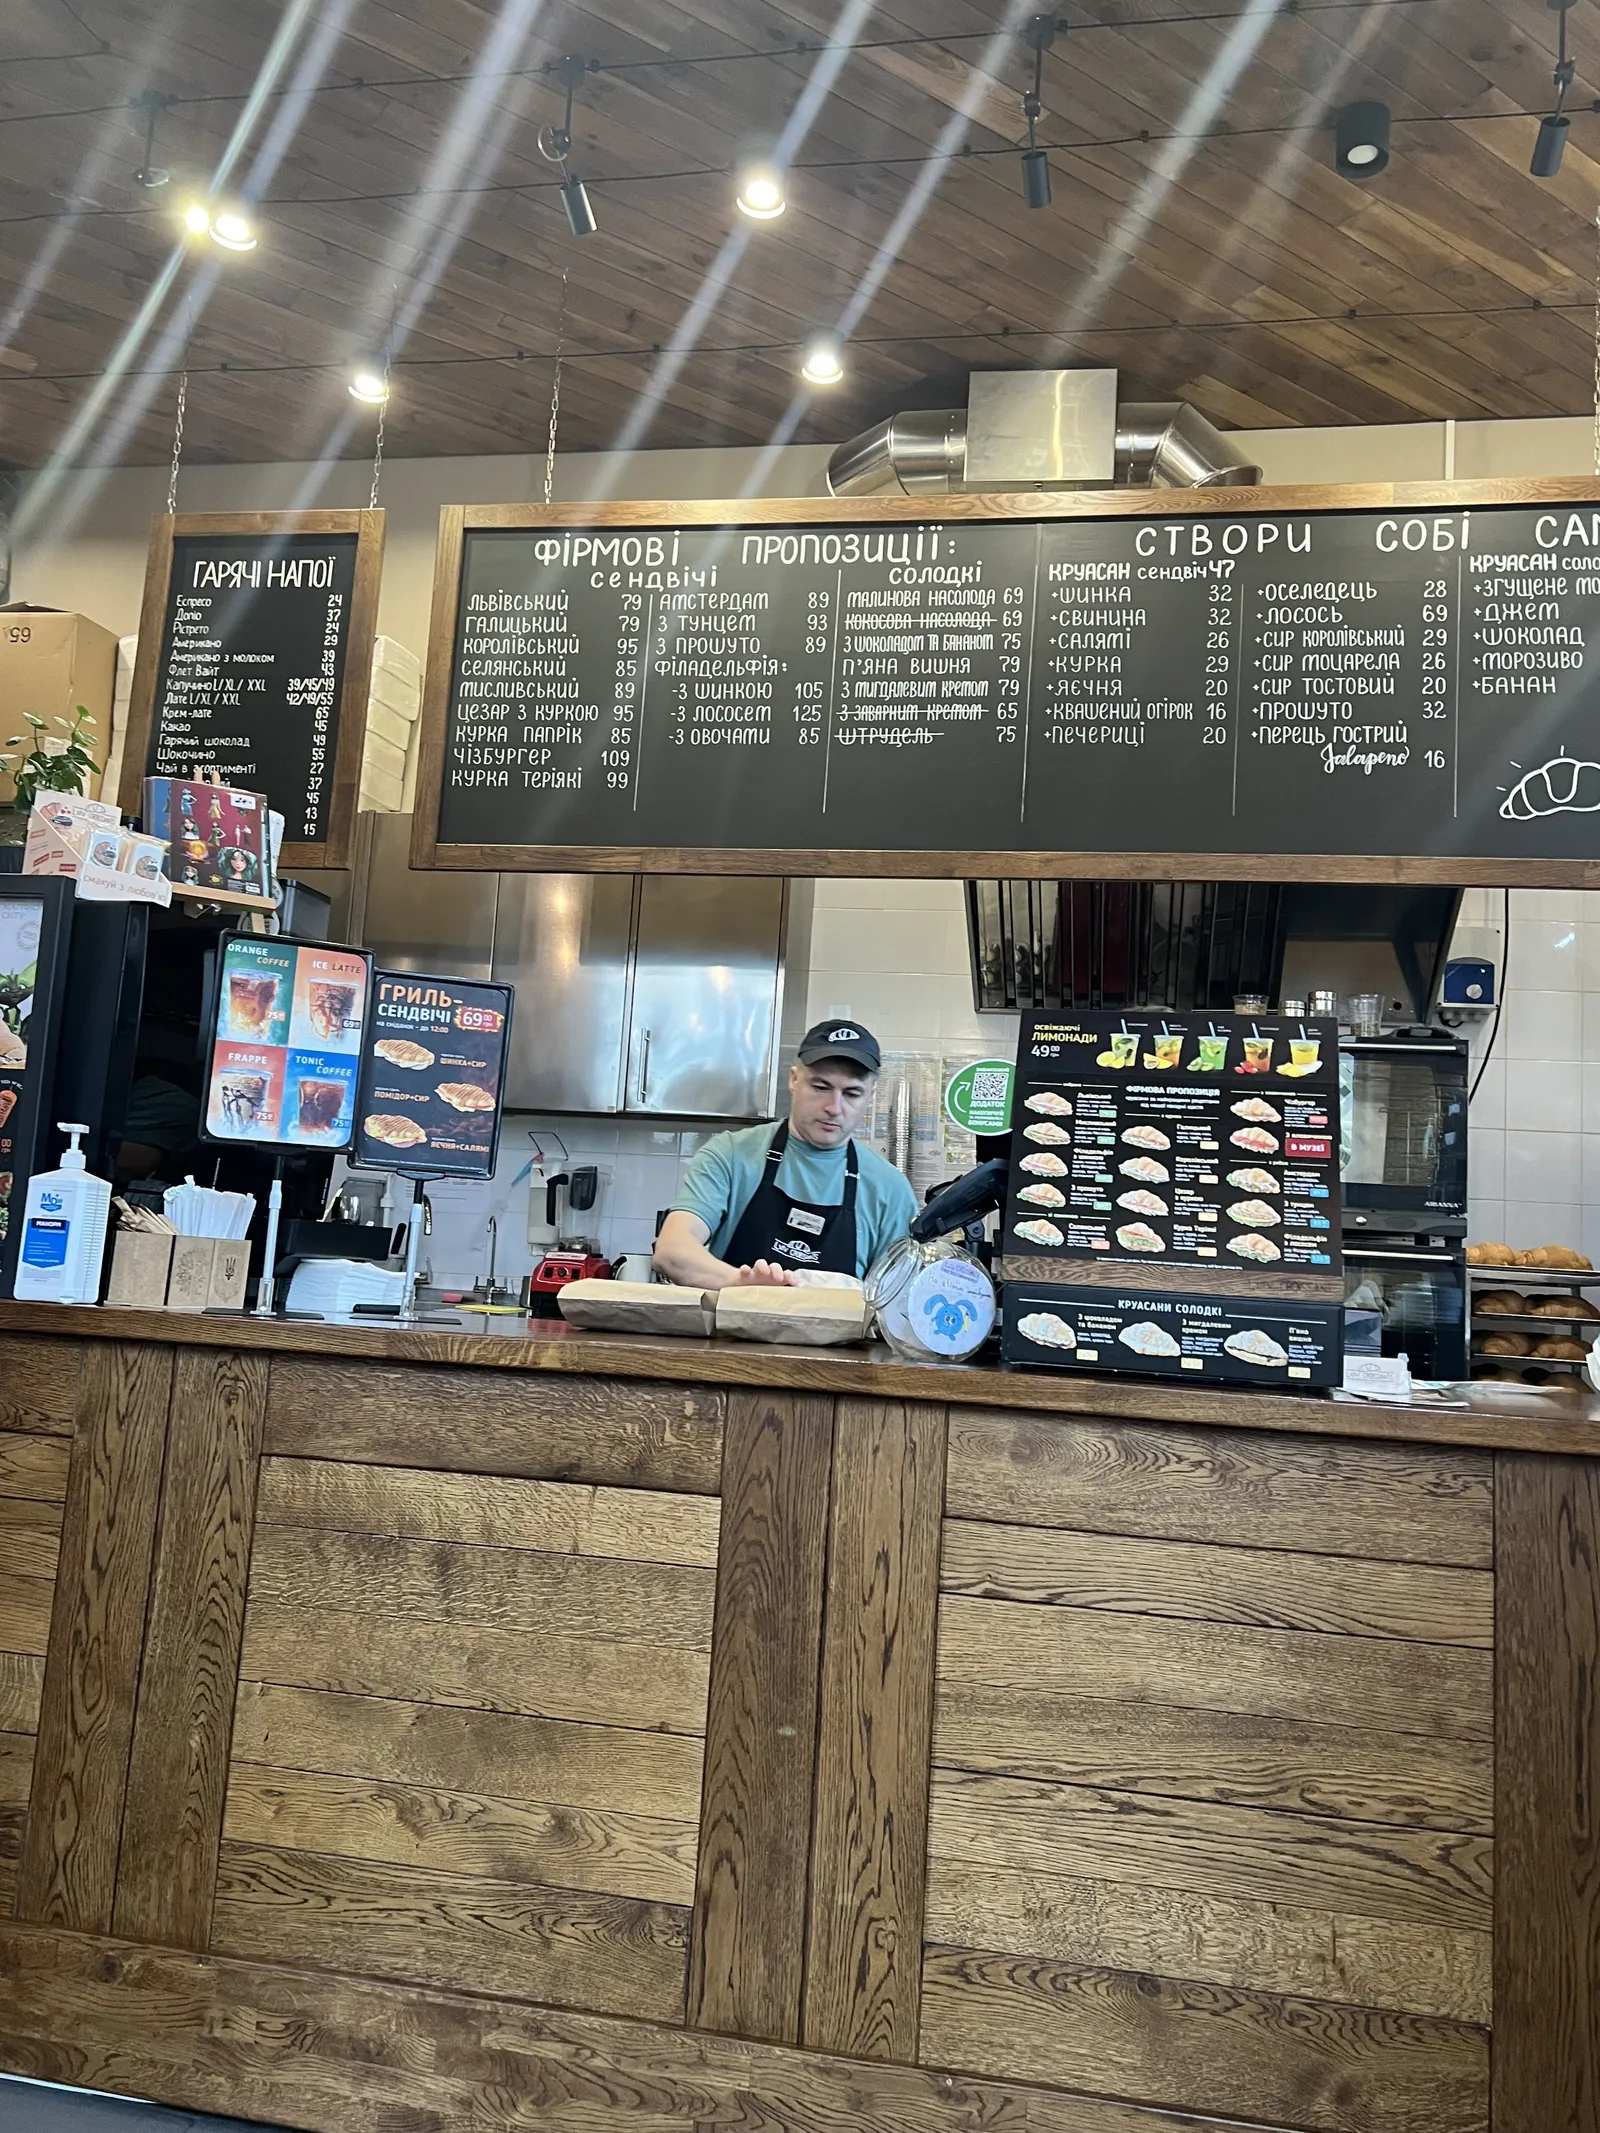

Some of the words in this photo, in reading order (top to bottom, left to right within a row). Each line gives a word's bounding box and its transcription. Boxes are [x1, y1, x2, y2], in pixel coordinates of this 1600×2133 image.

[1136, 524, 1310, 556] СТВОРИ
[1376, 512, 1470, 552] СОБІ
[535, 531, 680, 566] ФІРМОВІ
[740, 525, 956, 564] ПРОПОЗИЦІЇ:
[193, 560, 261, 588] ГАРЯЧІ
[267, 556, 336, 588] НАПОЇ
[1049, 563, 1130, 581] КРУАСАН
[1470, 553, 1557, 573] КРУАСАН
[591, 565, 717, 592] сендвічі
[889, 560, 982, 587] солодкі
[847, 590, 920, 607] МАЛИНОВА
[929, 589, 995, 608] НАСОЛОДА
[1004, 587, 1023, 604] 69
[1209, 585, 1232, 601] 32
[1424, 580, 1447, 597] 28
[177, 595, 212, 608] Еспресо
[328, 594, 342, 607] 24
[468, 589, 568, 611] ЛЬВІВСЬКИЙ
[621, 594, 641, 610] 79
[660, 593, 768, 612] АМСТЕРДАМ
[808, 592, 829, 608] 89
[175, 608, 202, 621] Допіо
[327, 609, 341, 621] 37
[1208, 608, 1231, 625] 32
[1423, 605, 1447, 622] 69
[173, 622, 209, 636] Рістрето
[325, 622, 339, 633] 24
[466, 612, 567, 635] ГАЛИЦЬКИЙ
[619, 616, 639, 632] 79
[677, 615, 755, 634] ТУНЦЕМ
[807, 614, 827, 631] 93
[464, 634, 579, 654] КОРОЛІВСЬКИЙ
[617, 638, 638, 655] 95
[854, 635, 924, 655] ШОКОЛАДОМ
[927, 634, 939, 651] ТА
[943, 634, 993, 651] БАНАНОМ
[1002, 633, 1021, 649] 75
[1207, 631, 1229, 648] 26
[1303, 624, 1404, 647] КОРОЛІВСЬКИЙ
[1422, 629, 1447, 646] 29
[676, 637, 760, 654] ПРОШУТО
[805, 637, 826, 653] 89
[462, 655, 565, 676] СЕЛЯНСЬКИЙ
[616, 660, 636, 677] 85
[911, 658, 970, 674] ВИШНЯ
[999, 656, 1020, 673] 79
[1206, 656, 1228, 673] 29
[1302, 653, 1400, 673] МОЦАРЕЛА
[1422, 652, 1445, 670] 26
[460, 677, 578, 699] МИСЛИВСЬКИЙ
[615, 682, 635, 699] 89
[695, 682, 772, 699] ШИНКОЮ
[795, 682, 823, 699] 105
[855, 681, 936, 701] МИГДАЛЕВИМ
[941, 680, 988, 697] КРЕМОМ
[998, 679, 1019, 695] 79
[1206, 680, 1227, 696] 20
[1302, 673, 1394, 695] ТОСТОВИЙ
[1422, 677, 1446, 694] 20
[163, 706, 212, 719] Крем-лате
[316, 706, 330, 719] 65
[458, 703, 509, 723] ЦЕЗАР
[535, 704, 598, 721] КУРКОЮ
[613, 705, 634, 722] 95
[693, 705, 771, 722] ЛОСОСЕМ
[793, 705, 822, 721] 125
[1147, 698, 1193, 720] ОГІРОК
[1207, 702, 1226, 719] 16
[1423, 701, 1446, 718] 32
[161, 721, 191, 731] Какао
[315, 720, 328, 731] 45
[456, 726, 507, 742] КУРКА
[524, 723, 581, 743] ПАПРІК
[611, 728, 631, 744] 85
[1333, 720, 1407, 743] ГОСТРИЙ
[159, 734, 199, 747] Гарячий
[204, 738, 250, 747] шоколад
[313, 735, 326, 746] 49
[691, 728, 770, 745] ОВОЧАМИ
[799, 728, 820, 744] 85
[1203, 727, 1226, 744] 20
[158, 748, 215, 759] Шокочино
[312, 748, 325, 760] 55
[454, 744, 551, 765] ЧІЗБУРГЕР
[601, 750, 629, 766] 109
[1424, 750, 1445, 768] 16
[452, 770, 508, 786] КУРКА
[522, 767, 582, 788] ТЕРІЯКІ
[607, 772, 628, 788] 99
[84, 874, 117, 890] смакуй
[227, 943, 269, 957] ORANGE
[256, 956, 290, 968] COFFEE
[312, 960, 329, 970] ICE
[331, 963, 362, 974] LATTE
[379, 983, 464, 1008] ГРИЛЬ-
[377, 1003, 451, 1024] СЕНДВІЧІ
[462, 1011, 483, 1027] 69
[1034, 1023, 1081, 1032] освіжаючі
[1031, 1031, 1098, 1044] ЛИМОНАДИ
[228, 1052, 268, 1065] FRAPPE
[295, 1055, 325, 1066] TONIC
[316, 1065, 353, 1077] COFFEE
[970, 1100, 1006, 1108] ДОДАТОК
[1118, 1299, 1172, 1313] КРУАСАНИ
[1175, 1304, 1222, 1317] СОЛОДКІ
